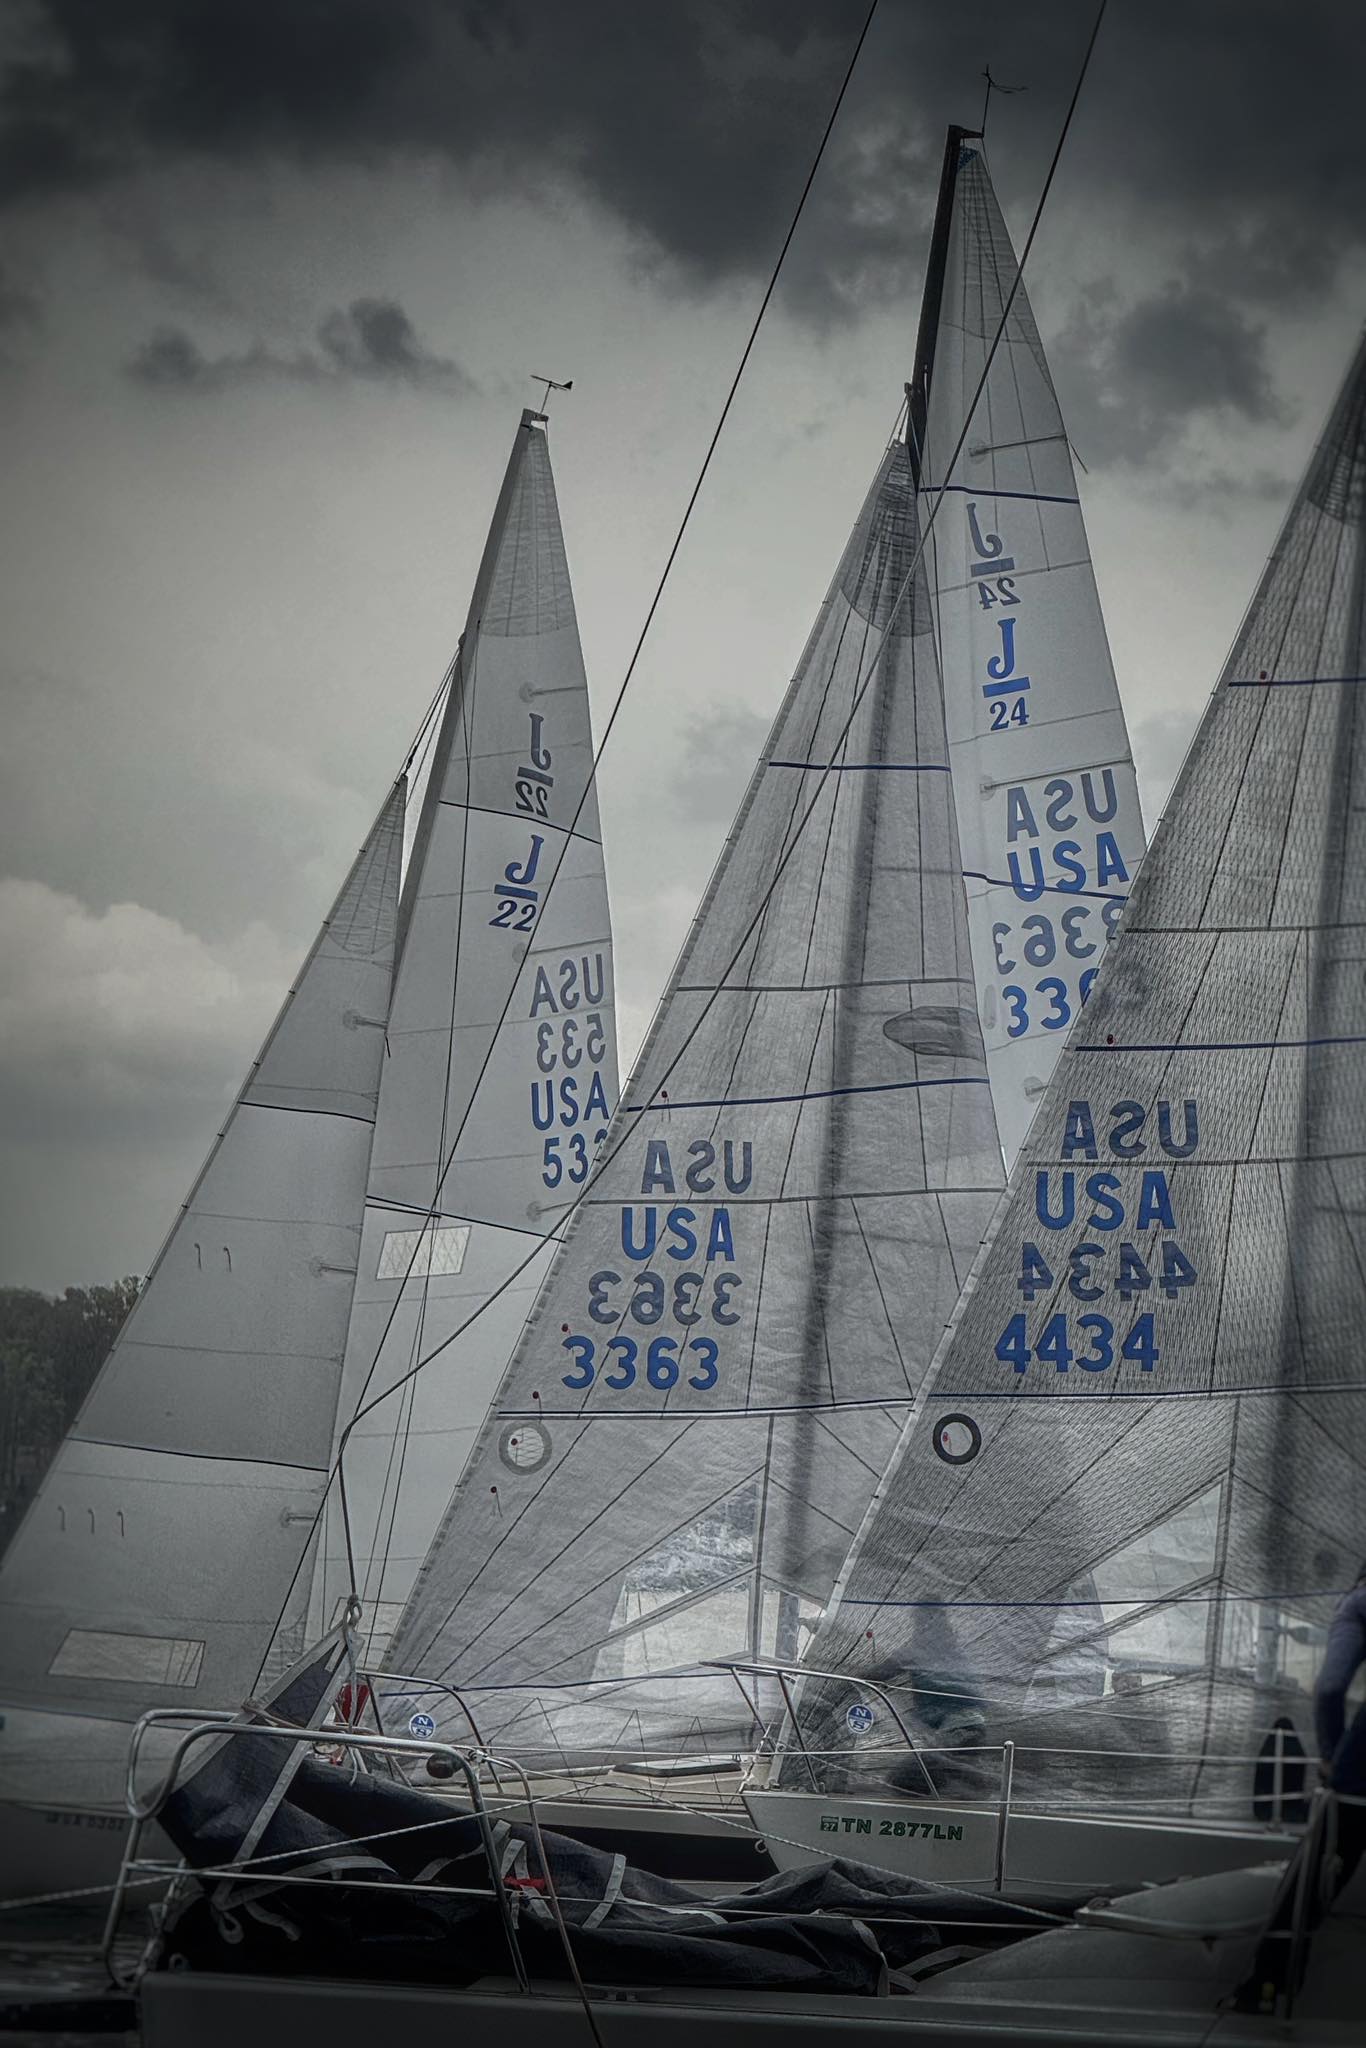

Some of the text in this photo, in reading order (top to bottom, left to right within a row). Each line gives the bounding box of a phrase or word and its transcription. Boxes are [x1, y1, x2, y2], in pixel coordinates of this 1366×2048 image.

[987, 617, 1017, 680] J
[989, 696, 1031, 732] 24
[504, 834, 545, 885] J
[1006, 831, 1130, 903] USA
[488, 899, 538, 933] 22
[531, 1071, 610, 1131] USA
[1035, 1171, 1177, 1232] USA
[621, 1206, 735, 1262] USA
[561, 1335, 719, 1391] 3363
[994, 1313, 1160, 1374] 4434
[842, 1817, 963, 1840] TN 2877LN
